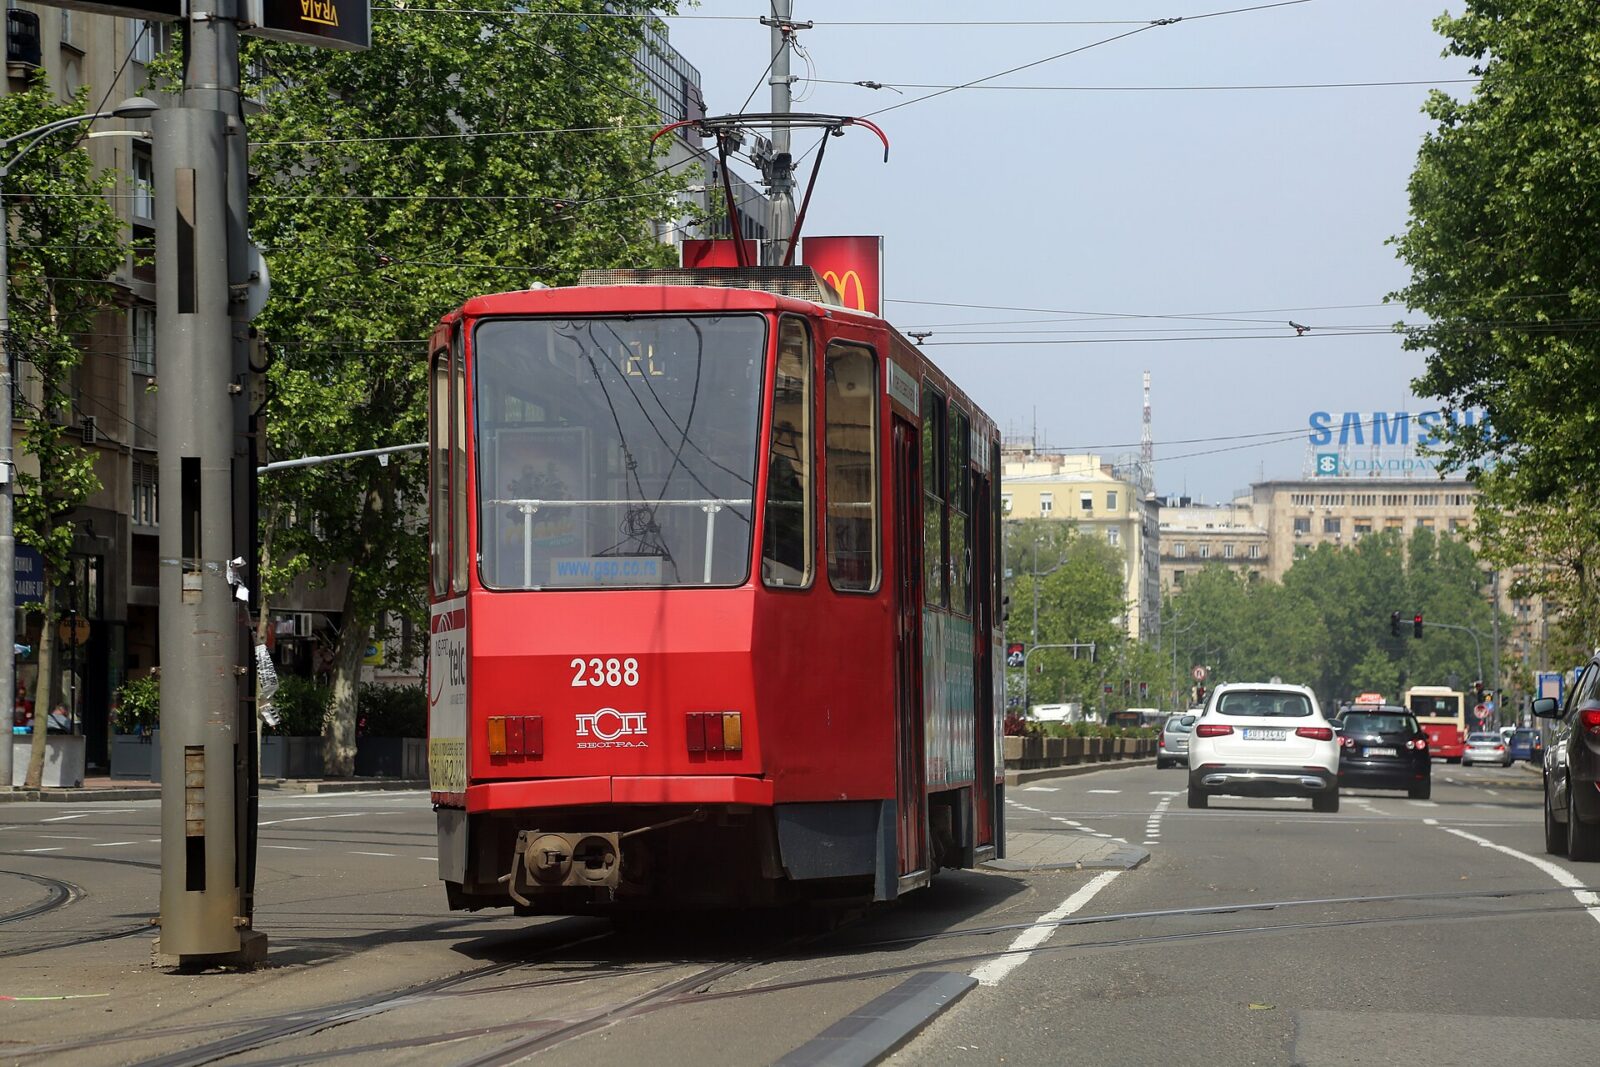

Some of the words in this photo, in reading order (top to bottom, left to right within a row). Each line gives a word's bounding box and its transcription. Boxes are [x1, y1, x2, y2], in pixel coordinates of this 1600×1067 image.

[557, 560, 657, 580] www.gsp.co.rs
[570, 657, 639, 687] 2388
[576, 707, 648, 741] ГСП
